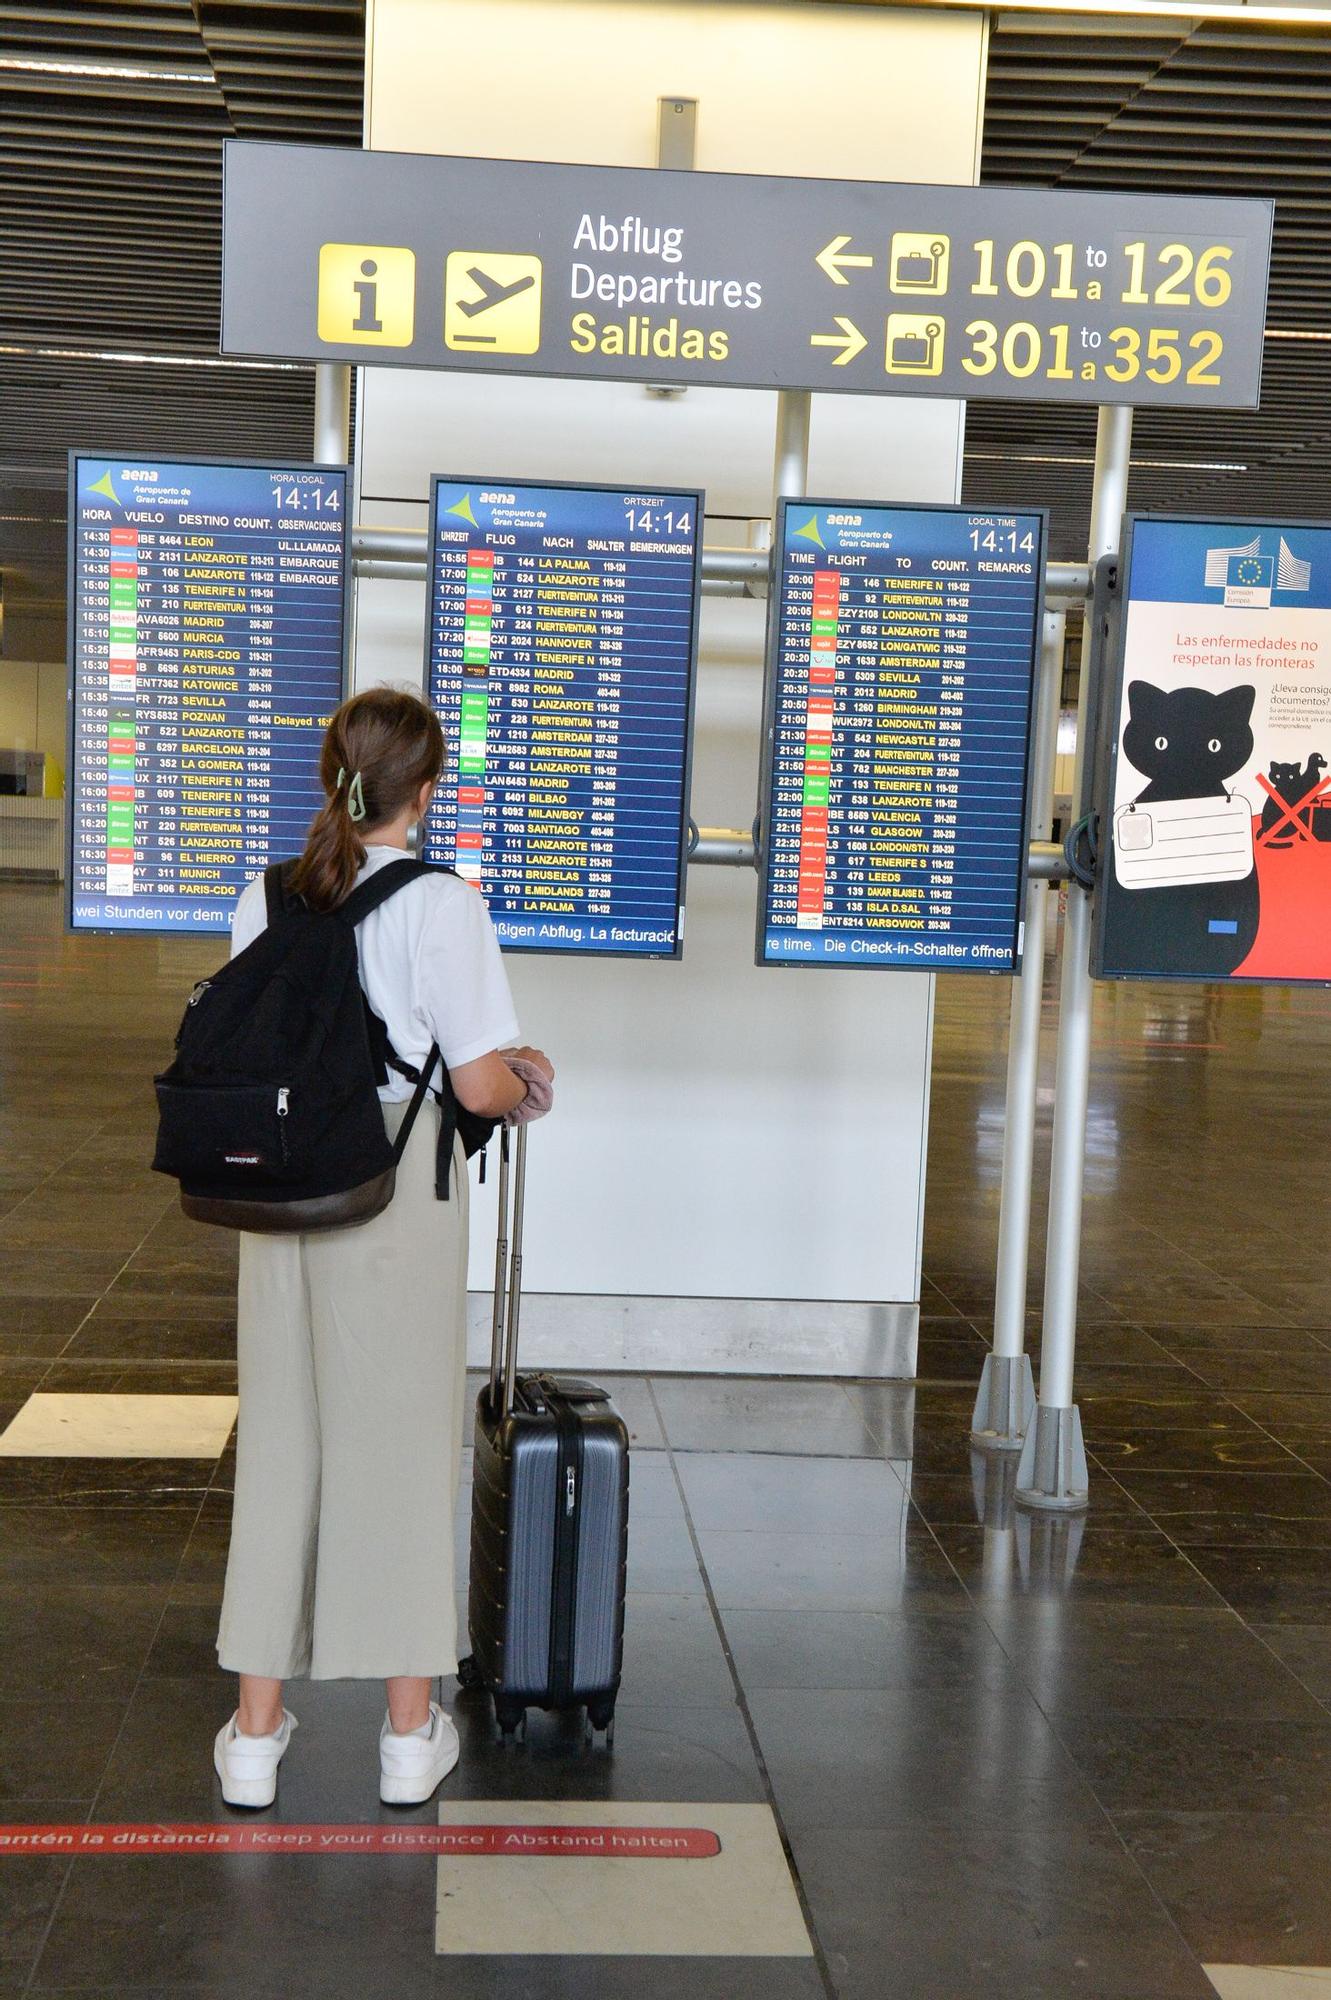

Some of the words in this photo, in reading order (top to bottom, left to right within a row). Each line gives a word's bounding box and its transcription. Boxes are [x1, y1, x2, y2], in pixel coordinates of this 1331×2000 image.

[573, 214, 684, 263] Abflug
[1085, 245, 1108, 269] to
[969, 240, 1079, 301] 101
[1120, 242, 1234, 308] 126
[570, 263, 762, 309] Departures
[1086, 279, 1102, 301] a
[570, 312, 729, 361] Salidas
[1081, 326, 1102, 348] to
[961, 319, 1073, 380] 301
[1103, 326, 1224, 386] 352
[1081, 361, 1096, 381] a
[121, 469, 158, 482] aena
[270, 474, 295, 482] HORA
[297, 476, 324, 484] LOCAL
[133, 486, 178, 495] Aeropuerto
[181, 488, 191, 496] de
[272, 486, 340, 512] 14:14
[479, 492, 515, 505] aena
[624, 497, 664, 506] ORTSZEIT
[82, 509, 112, 520] HORA
[125, 512, 164, 523] VUELO
[179, 514, 229, 526] DESTINO
[234, 517, 273, 529] COUNT.
[278, 519, 342, 532] OBSERVACIONES
[491, 509, 535, 518] Aeropuerto
[827, 514, 862, 526] aena
[493, 518, 512, 526] Gran
[625, 509, 691, 535] 14:14
[968, 518, 995, 526] LOCAL
[83, 532, 110, 542] 14:30
[138, 535, 155, 543] IBE
[184, 537, 214, 546] LEON
[278, 541, 341, 553] UL.LLAMADA
[837, 530, 881, 539] Aeropuerto
[883, 531, 892, 539] de
[970, 529, 1034, 554] 14:14
[441, 531, 469, 542] UHRZEIT
[486, 534, 516, 545] FLUG
[543, 537, 574, 548] NACH
[587, 539, 625, 552] SHALTER
[630, 542, 692, 555] BEMERKUNGEN
[83, 548, 110, 557] 14:30
[138, 551, 152, 560] UX
[159, 552, 180, 561] 2131
[184, 553, 248, 564] LANZAROTE
[280, 557, 339, 569] EMBARQUE
[494, 556, 504, 565] IB
[518, 558, 534, 567] 144
[539, 559, 553, 568] LA
[555, 560, 590, 570] PALMA
[790, 553, 815, 563] TIME
[828, 555, 867, 566] FLIGHT
[896, 557, 911, 568] TO
[932, 560, 969, 571] COUNT.
[978, 562, 1031, 573] REMARKS
[82, 564, 109, 574] 14:35
[137, 567, 148, 575] IB
[184, 568, 245, 580] LANZAROTE
[279, 574, 339, 585] EMBARQUE
[788, 575, 813, 584] 20:00
[840, 577, 850, 586] IB
[885, 579, 933, 590] TENERIFE
[936, 582, 943, 590] N
[439, 633, 464, 642] 17:20
[491, 636, 507, 645] CXI
[511, 636, 531, 646] 2024
[536, 638, 593, 649] HANNOVER
[1176, 633, 1198, 646] Las
[1202, 635, 1297, 651] enfermedades
[1301, 641, 1318, 652] no
[784, 653, 809, 662] 20:20
[836, 655, 850, 664] OR
[880, 657, 940, 668] AMSTERDAM
[1173, 653, 1231, 667] respetan
[1235, 654, 1252, 666] las
[1256, 655, 1315, 669] fronteras
[436, 680, 462, 689] 18:05
[489, 682, 502, 691] FR
[533, 684, 564, 695] ROMA
[1271, 684, 1297, 694] ¿Lleva
[136, 695, 150, 704] FR
[182, 696, 226, 707] SEVILLA
[1270, 695, 1330, 706] documentos?
[182, 712, 225, 722] POZNAN
[273, 715, 312, 727] Delayed
[780, 731, 805, 740] 21:30
[832, 732, 844, 742] LS
[855, 734, 871, 743] 542
[876, 734, 935, 746] NEWCASTLE
[780, 745, 804, 755] 21:45
[831, 748, 845, 757] NT
[854, 749, 870, 758] 204
[874, 750, 934, 761] FUERTEVENTURA
[135, 758, 149, 767] NT
[160, 759, 177, 768] 352
[182, 760, 195, 769] LA
[198, 761, 243, 770] GOMERA
[431, 820, 456, 829] 19:30
[483, 822, 496, 831] FR
[527, 825, 580, 835] SANTIAGO
[871, 827, 922, 837] GLASGOW
[79, 881, 106, 891] 16:45
[133, 883, 154, 892] ENT
[179, 884, 236, 895] PARIS-CDG
[524, 886, 584, 897] E.MIDLANDS
[76, 905, 100, 917] wei
[104, 905, 163, 919] Stunden
[165, 910, 189, 920] vor
[192, 909, 223, 921] dem
[772, 900, 797, 909] 23:00
[823, 901, 833, 911] IB
[867, 903, 889, 913] ISLA
[892, 903, 920, 914] D.SAL
[539, 925, 585, 941] Abflug.
[590, 927, 607, 940] La
[783, 938, 816, 951] time.
[824, 938, 846, 953] Die
[851, 940, 966, 957] Check-in-Schalter
[971, 944, 1013, 958] öffnen
[81, 1833, 104, 1845] la
[112, 1832, 230, 1844] distancia
[252, 1832, 311, 1846] Keep
[321, 1833, 374, 1845] your
[382, 1832, 484, 1845] distance
[504, 1833, 604, 1847] Abstand
[613, 1835, 688, 1848] halten
